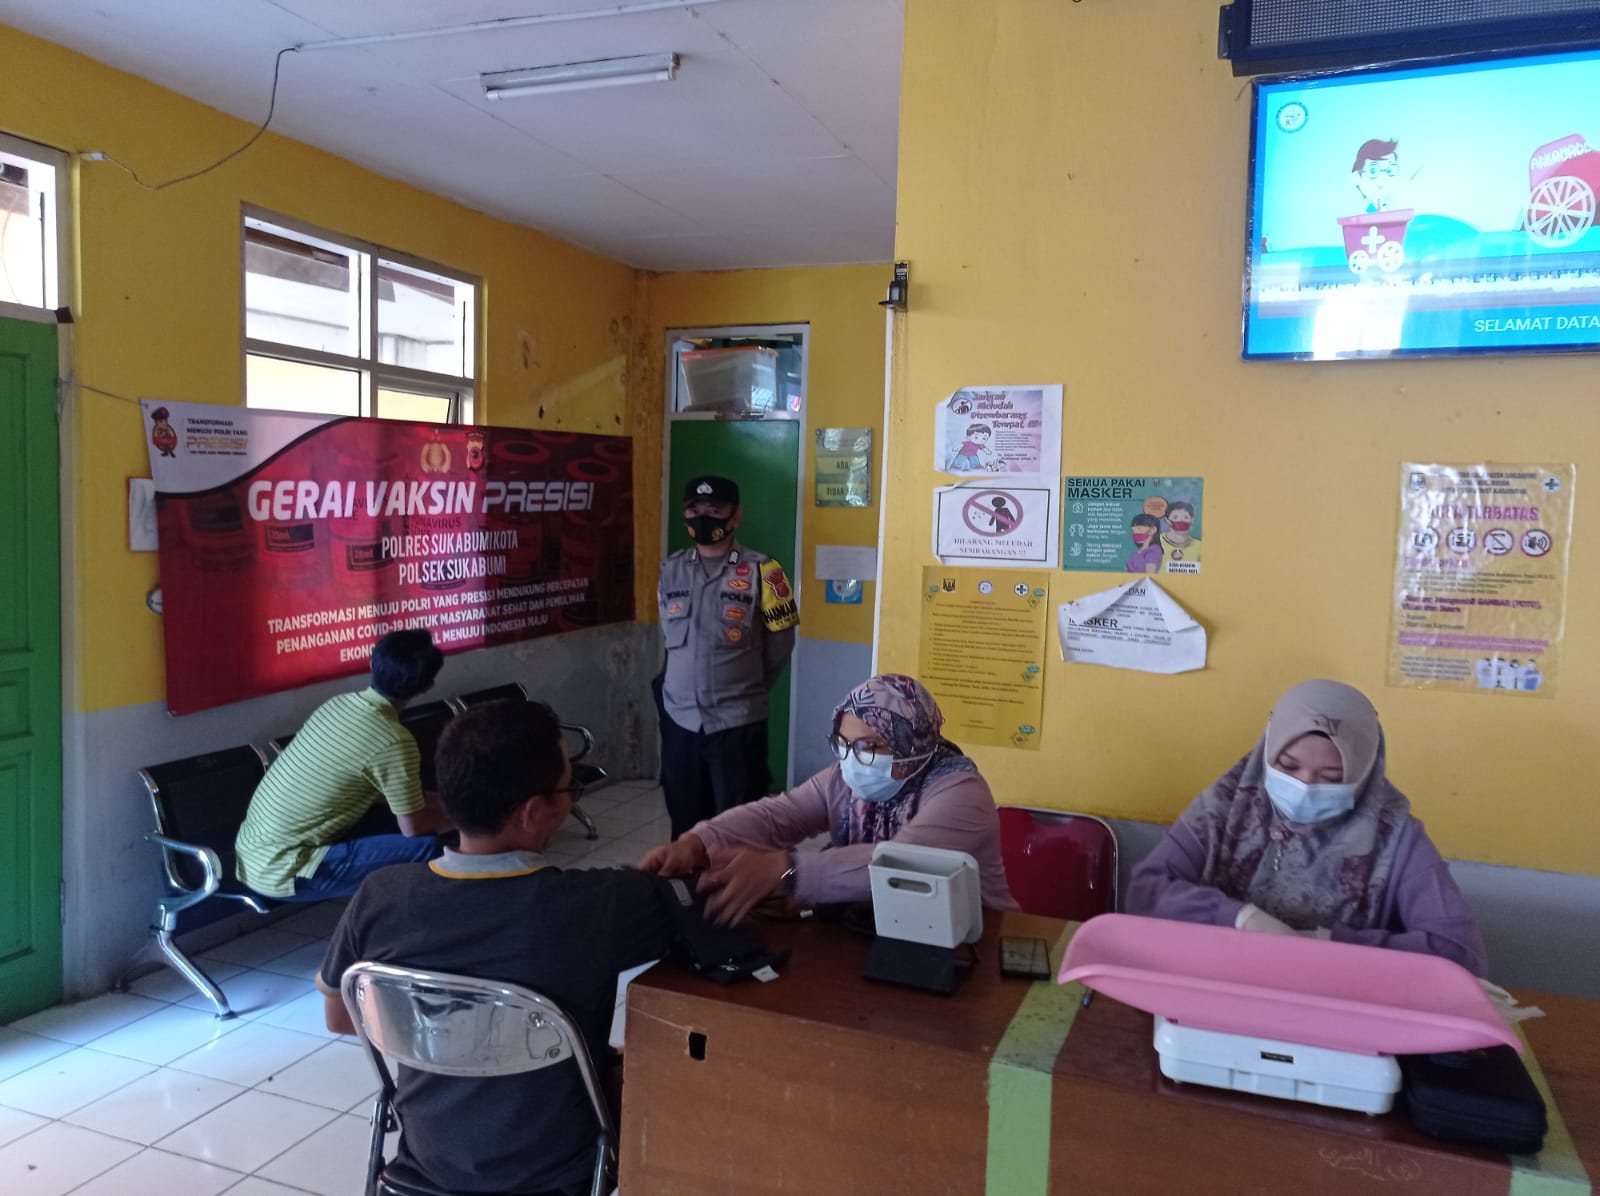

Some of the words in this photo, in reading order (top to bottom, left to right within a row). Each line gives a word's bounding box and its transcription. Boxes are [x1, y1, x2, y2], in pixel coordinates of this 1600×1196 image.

[1474, 317, 1552, 333] SELAMAT
[1068, 479, 1108, 487] SEMUA
[1111, 479, 1145, 487] PAKAI
[1068, 488, 1132, 498] MASKER
[248, 480, 356, 521] GERAI
[366, 480, 476, 517] VAKSIN
[482, 481, 594, 513] PRESISI
[382, 534, 429, 559] POLRES
[960, 547, 1017, 555] SEMBARANGAN
[994, 539, 1033, 547] MELUDAH
[399, 560, 449, 585] POLSEK
[448, 556, 506, 580] SUKABUMI
[268, 608, 355, 634] TRANSFORMASI
[358, 601, 399, 619] MENUJU
[401, 597, 430, 613] POLRI
[433, 594, 459, 607] YANG
[461, 590, 495, 605] PRESISI
[497, 583, 545, 599] MENDUKUNG
[276, 628, 355, 654] PENANGANAN
[357, 620, 403, 639] COVID-19
[405, 615, 439, 631] UNTUK
[440, 607, 501, 626] MASYARAKAT
[502, 602, 528, 616] SEHAT
[443, 626, 480, 643] MENUJU
[482, 619, 526, 636] INDONESIA
[527, 615, 549, 628] MAJU
[340, 643, 376, 662] EKONO
